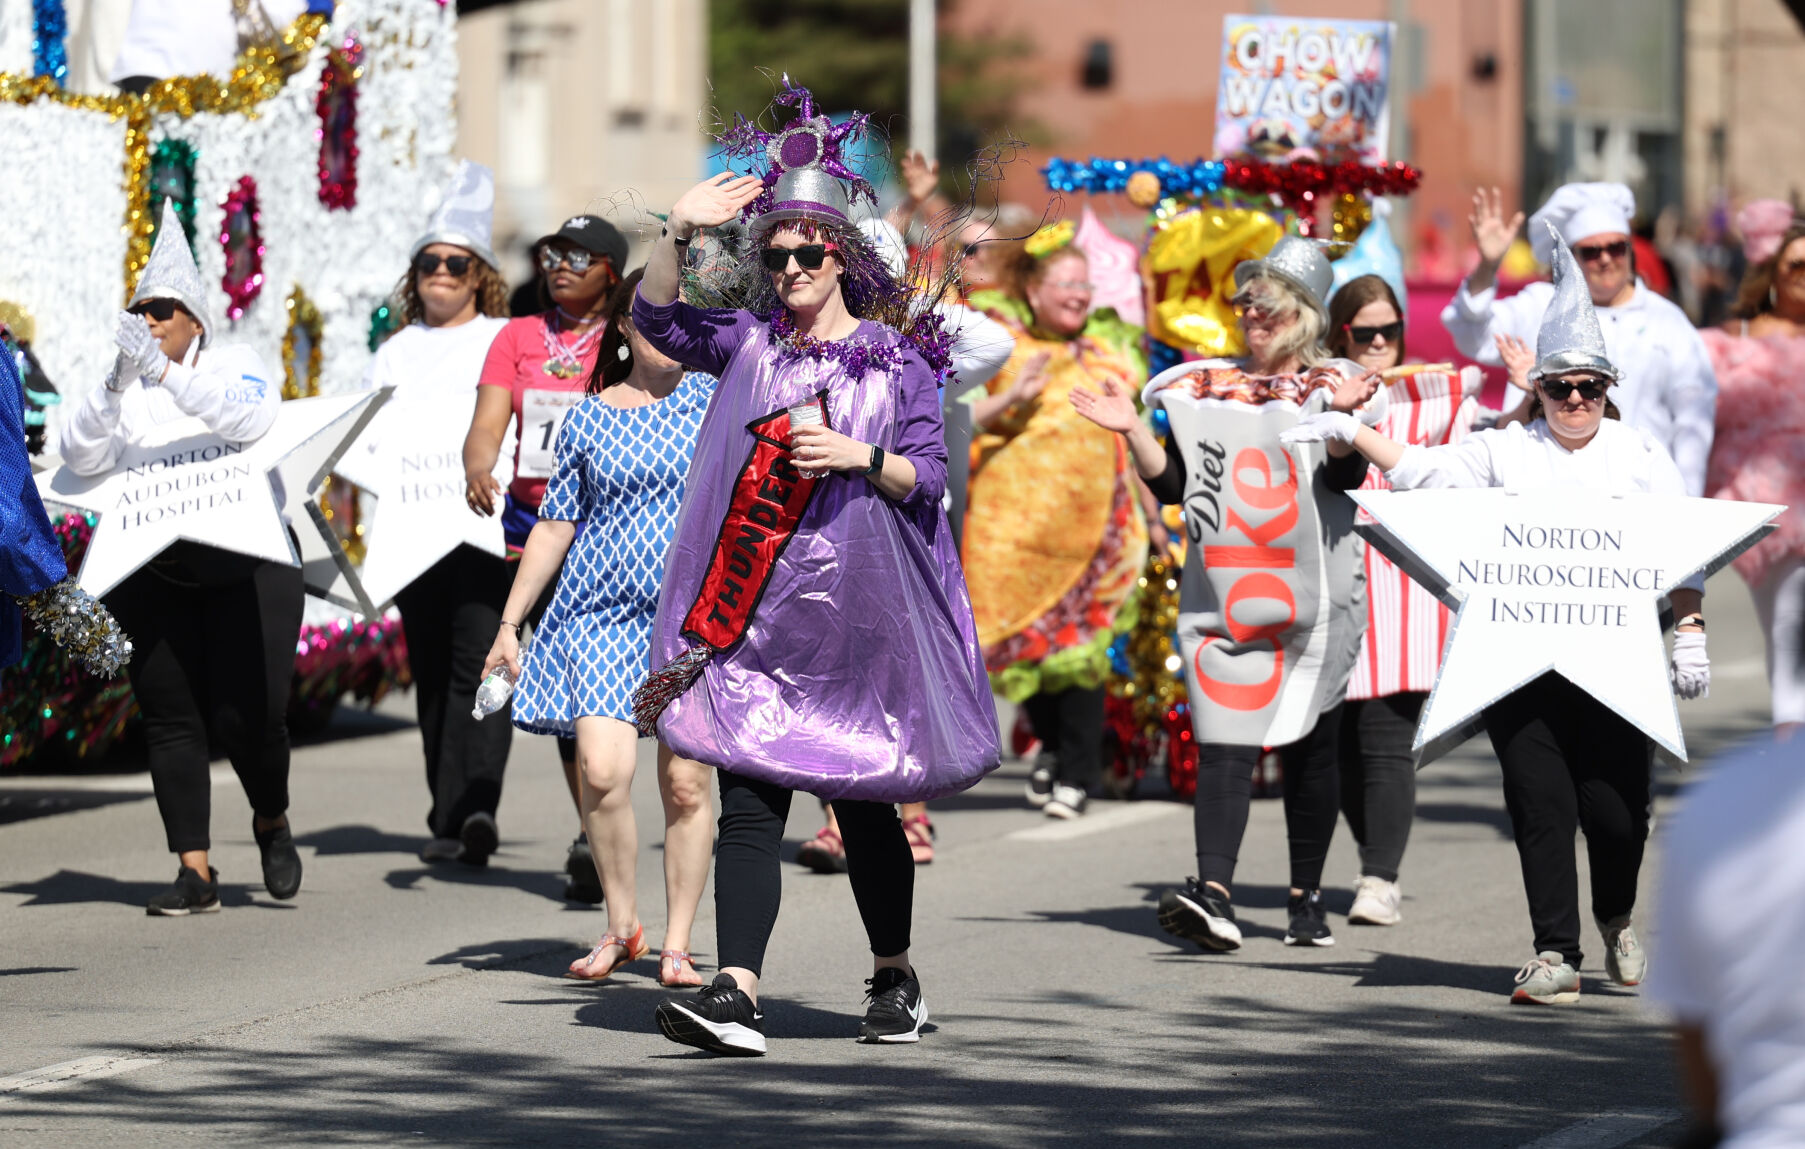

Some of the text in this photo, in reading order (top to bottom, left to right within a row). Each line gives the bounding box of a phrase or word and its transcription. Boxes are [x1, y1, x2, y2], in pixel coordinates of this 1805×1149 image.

[1236, 31, 1374, 74] CHOW
[1227, 77, 1383, 120] WAGON
[126, 441, 242, 482] NORTON
[116, 463, 250, 509] AUDUBON
[1183, 439, 1226, 544] Diet
[122, 488, 248, 530] HOSPITAL
[706, 456, 799, 627] THUNDER
[1501, 523, 1623, 550] NORTON
[1194, 446, 1300, 711] Coke
[1457, 560, 1665, 591] NEUROSCIENCE
[1490, 597, 1628, 627] INSTITUTE
